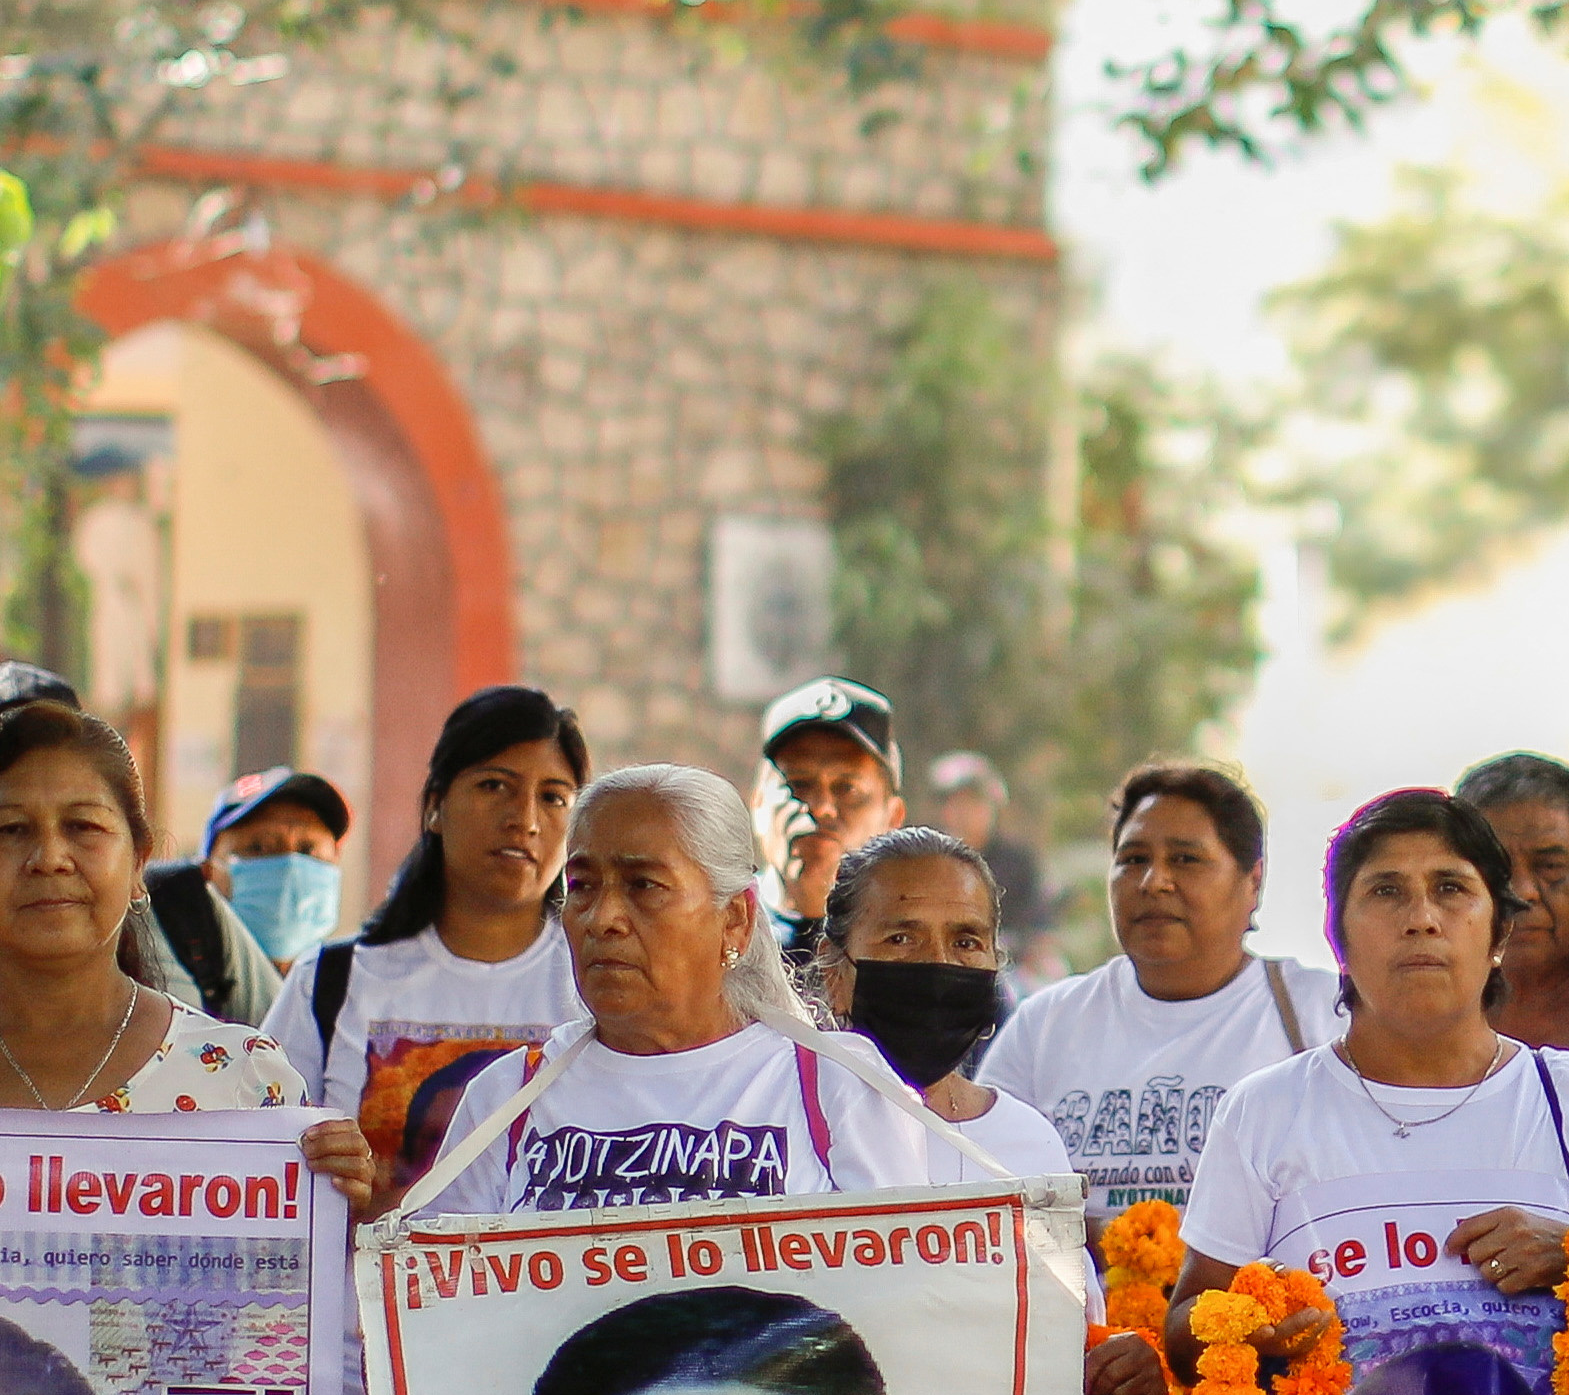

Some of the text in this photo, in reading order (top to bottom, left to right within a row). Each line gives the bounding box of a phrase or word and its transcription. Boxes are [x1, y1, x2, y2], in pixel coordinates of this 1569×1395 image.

[526, 1128, 784, 1188] AYOTZINAPA
[1145, 1166, 1174, 1183] con
[29, 1155, 299, 1219] llevaron!
[1107, 1188, 1191, 1206] AYOTZINA
[44, 1248, 109, 1268] quiero
[123, 1252, 177, 1268] saber
[189, 1253, 243, 1270] dónde
[256, 1253, 299, 1270] está
[405, 1212, 1004, 1310] ¡Vivo se lo llevaron!
[1307, 1222, 1439, 1287] se lo
[1391, 1301, 1474, 1324] Escocia,
[1482, 1301, 1541, 1321] quiero
